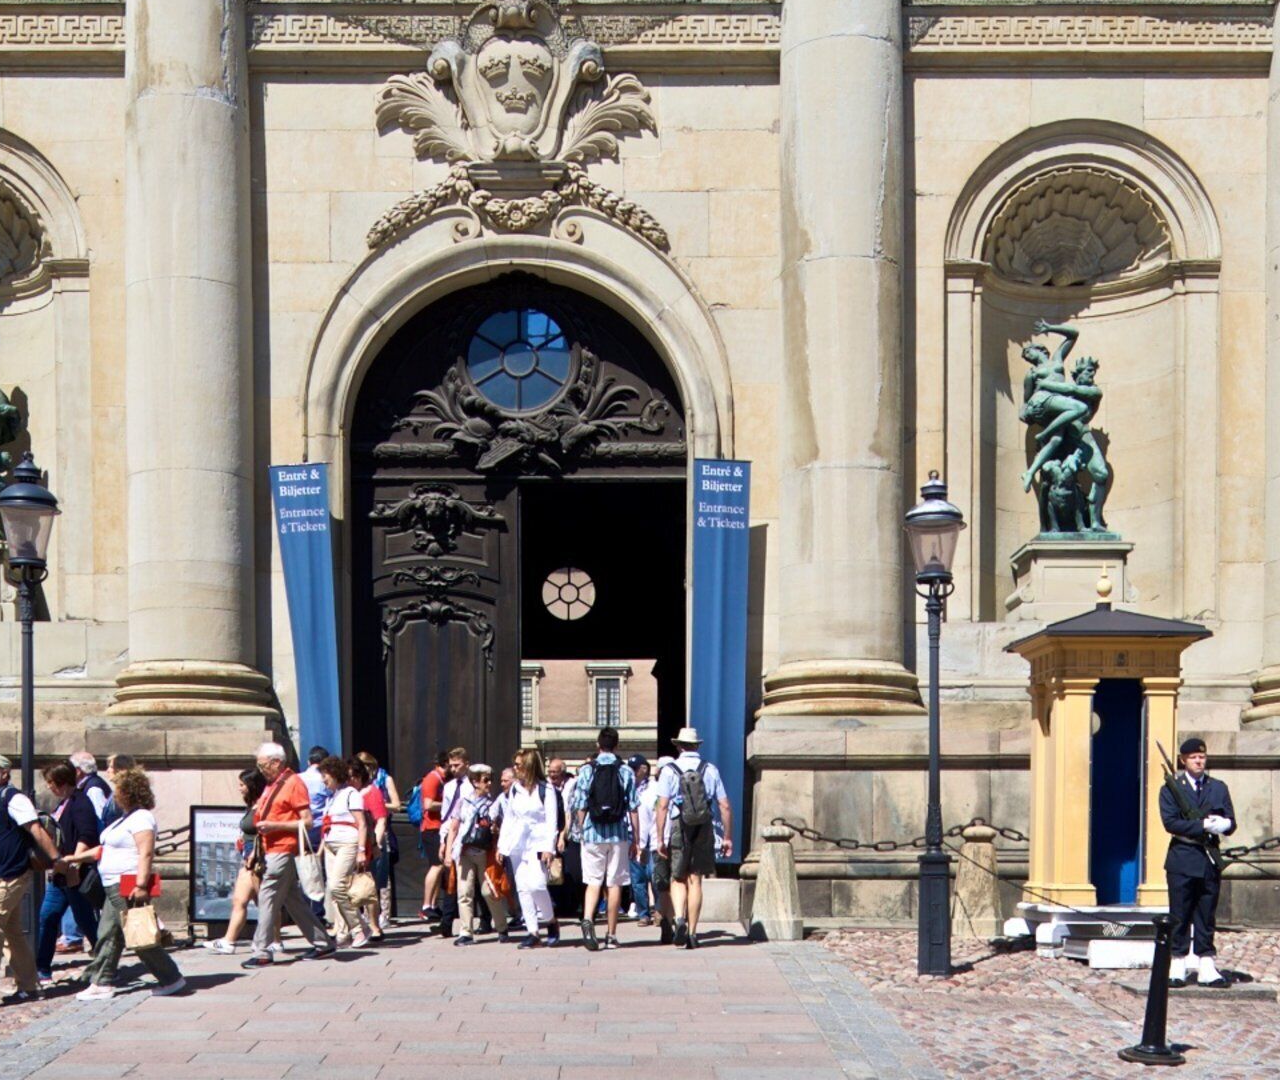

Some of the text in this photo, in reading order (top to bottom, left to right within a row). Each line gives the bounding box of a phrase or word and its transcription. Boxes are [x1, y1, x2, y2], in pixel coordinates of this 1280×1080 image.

[278, 469, 320, 482] Entré &
[702, 465, 743, 477] Entré &
[279, 485, 321, 497] Biljetter
[702, 480, 743, 492] Biljetter
[279, 508, 325, 519] Entrance
[699, 502, 745, 514] Entrance
[288, 521, 327, 533] Tickets
[697, 516, 745, 529] & Tickets
